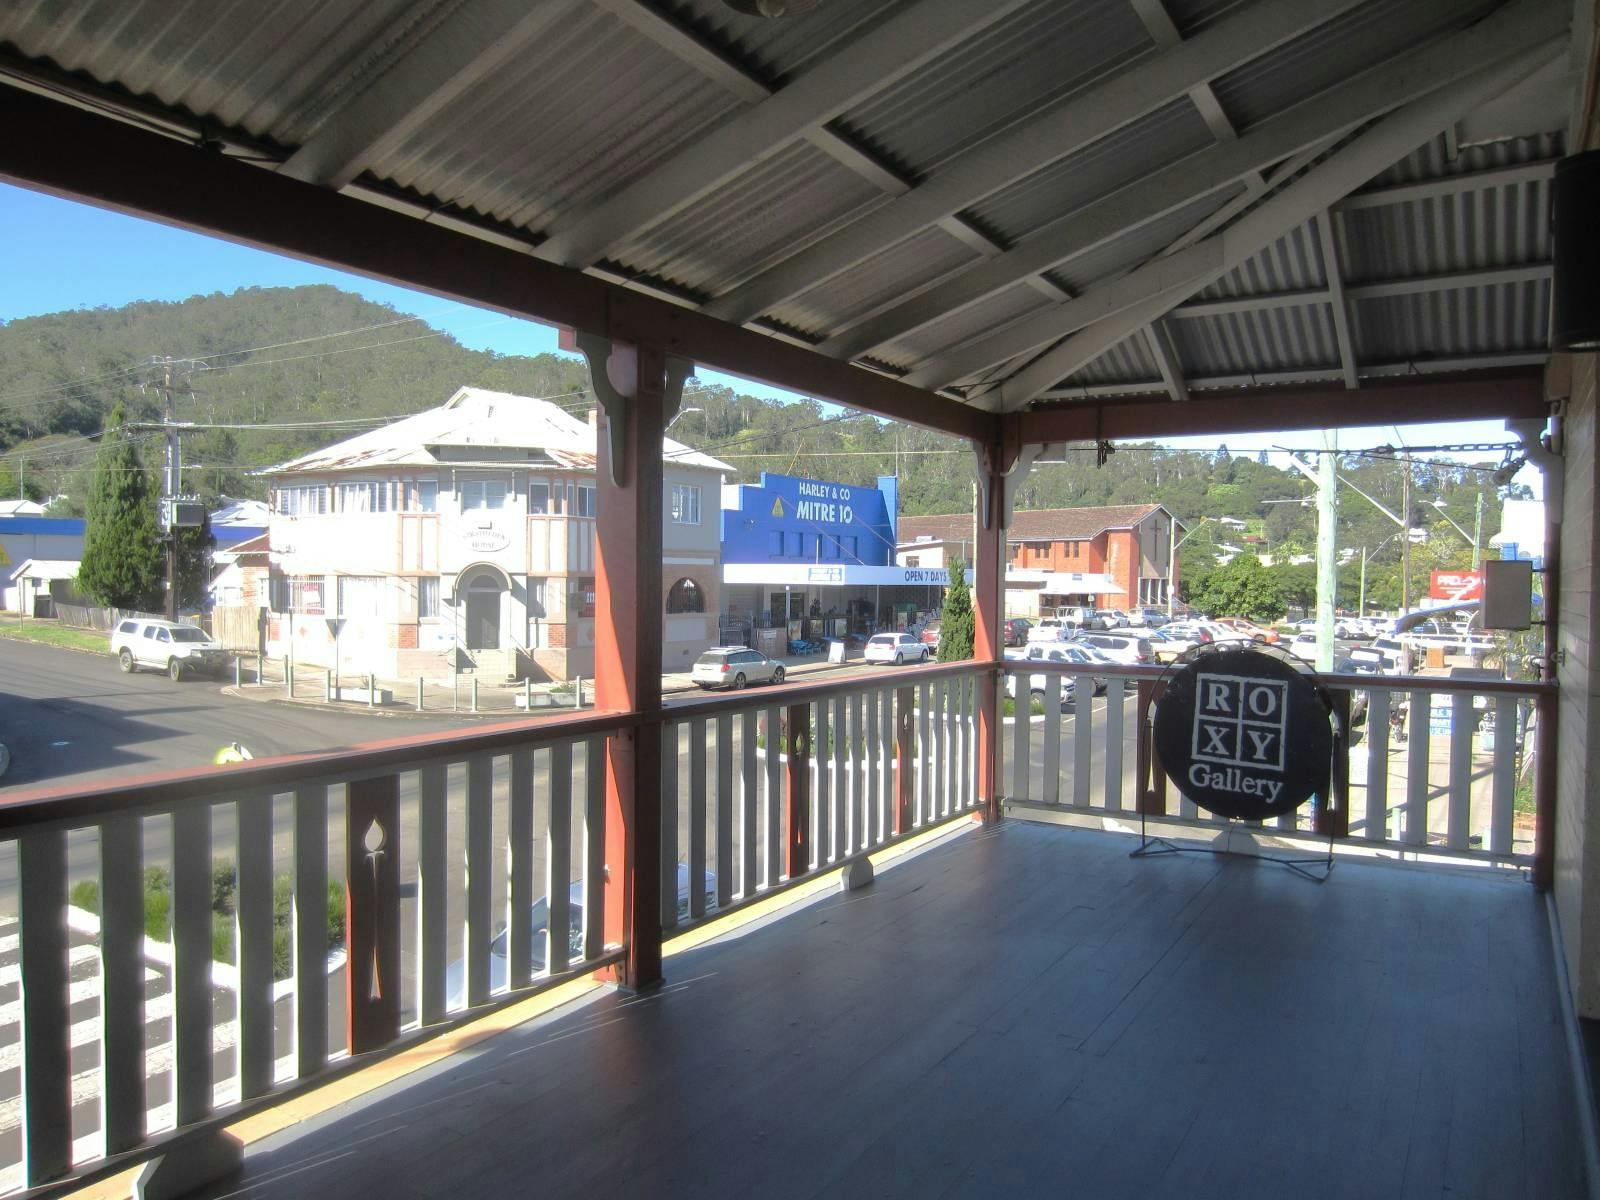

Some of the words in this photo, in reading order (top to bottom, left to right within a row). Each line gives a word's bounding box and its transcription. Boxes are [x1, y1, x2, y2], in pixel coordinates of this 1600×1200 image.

[799, 482, 830, 498] HARLEY
[832, 487, 838, 500] &
[840, 488, 850, 501] CO
[797, 501, 835, 522] MITRE
[839, 504, 853, 524] 10
[904, 570, 923, 582] OPEN
[925, 571, 929, 581] 7
[930, 571, 947, 582] DAYS
[1188, 763, 1283, 803] Gallery
